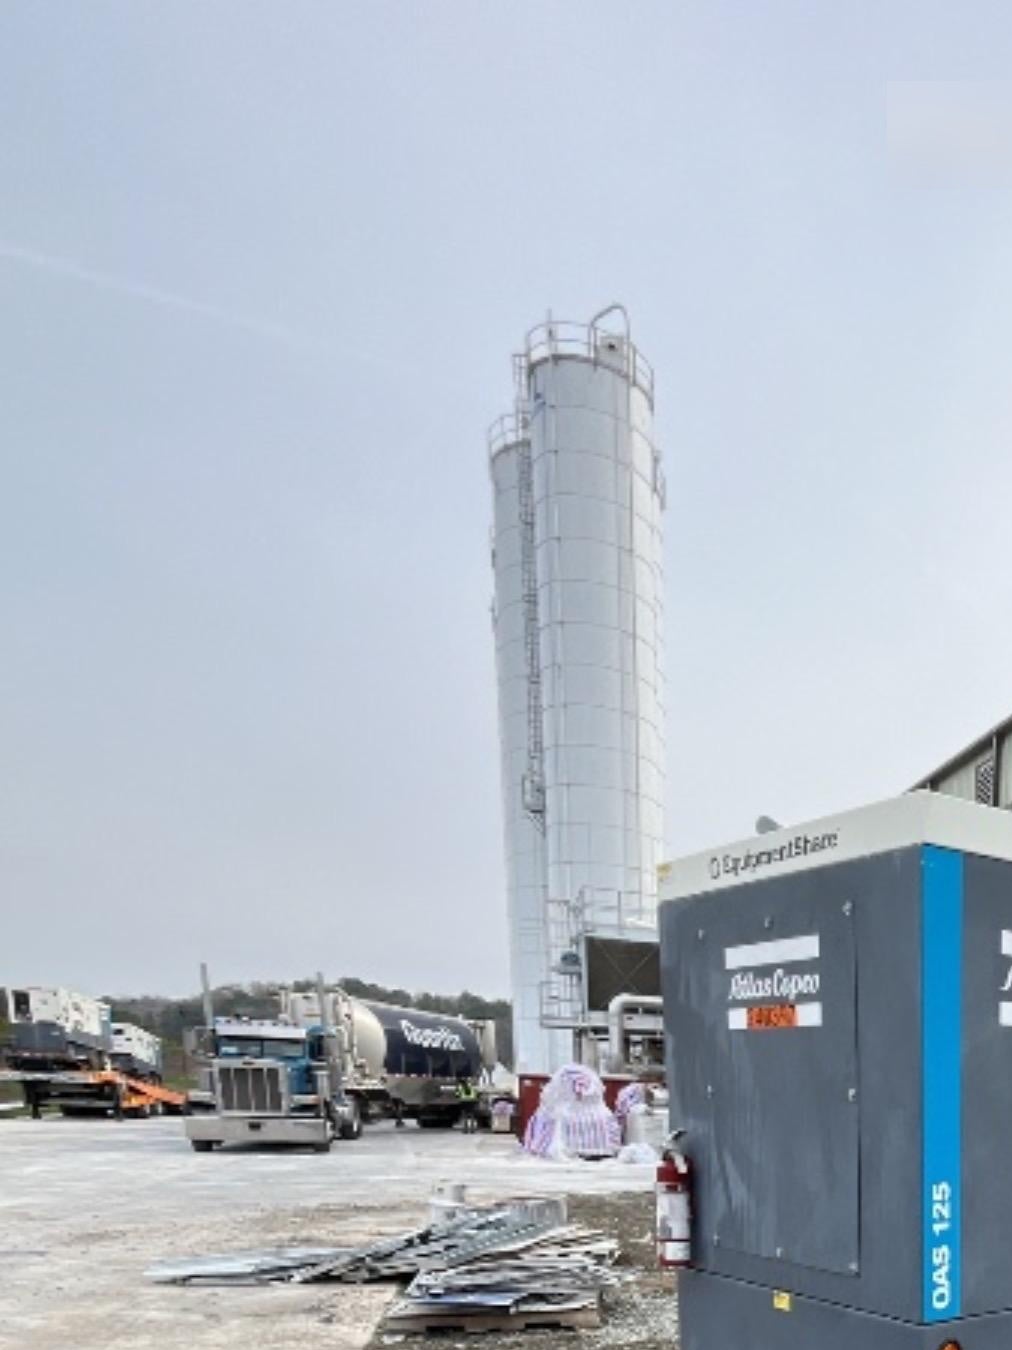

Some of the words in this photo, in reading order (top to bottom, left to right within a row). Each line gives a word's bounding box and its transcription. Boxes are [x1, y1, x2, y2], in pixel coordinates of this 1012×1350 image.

[728, 971, 772, 1000] Atlas
[773, 968, 820, 1001] Copco
[932, 1181, 952, 1237] 125
